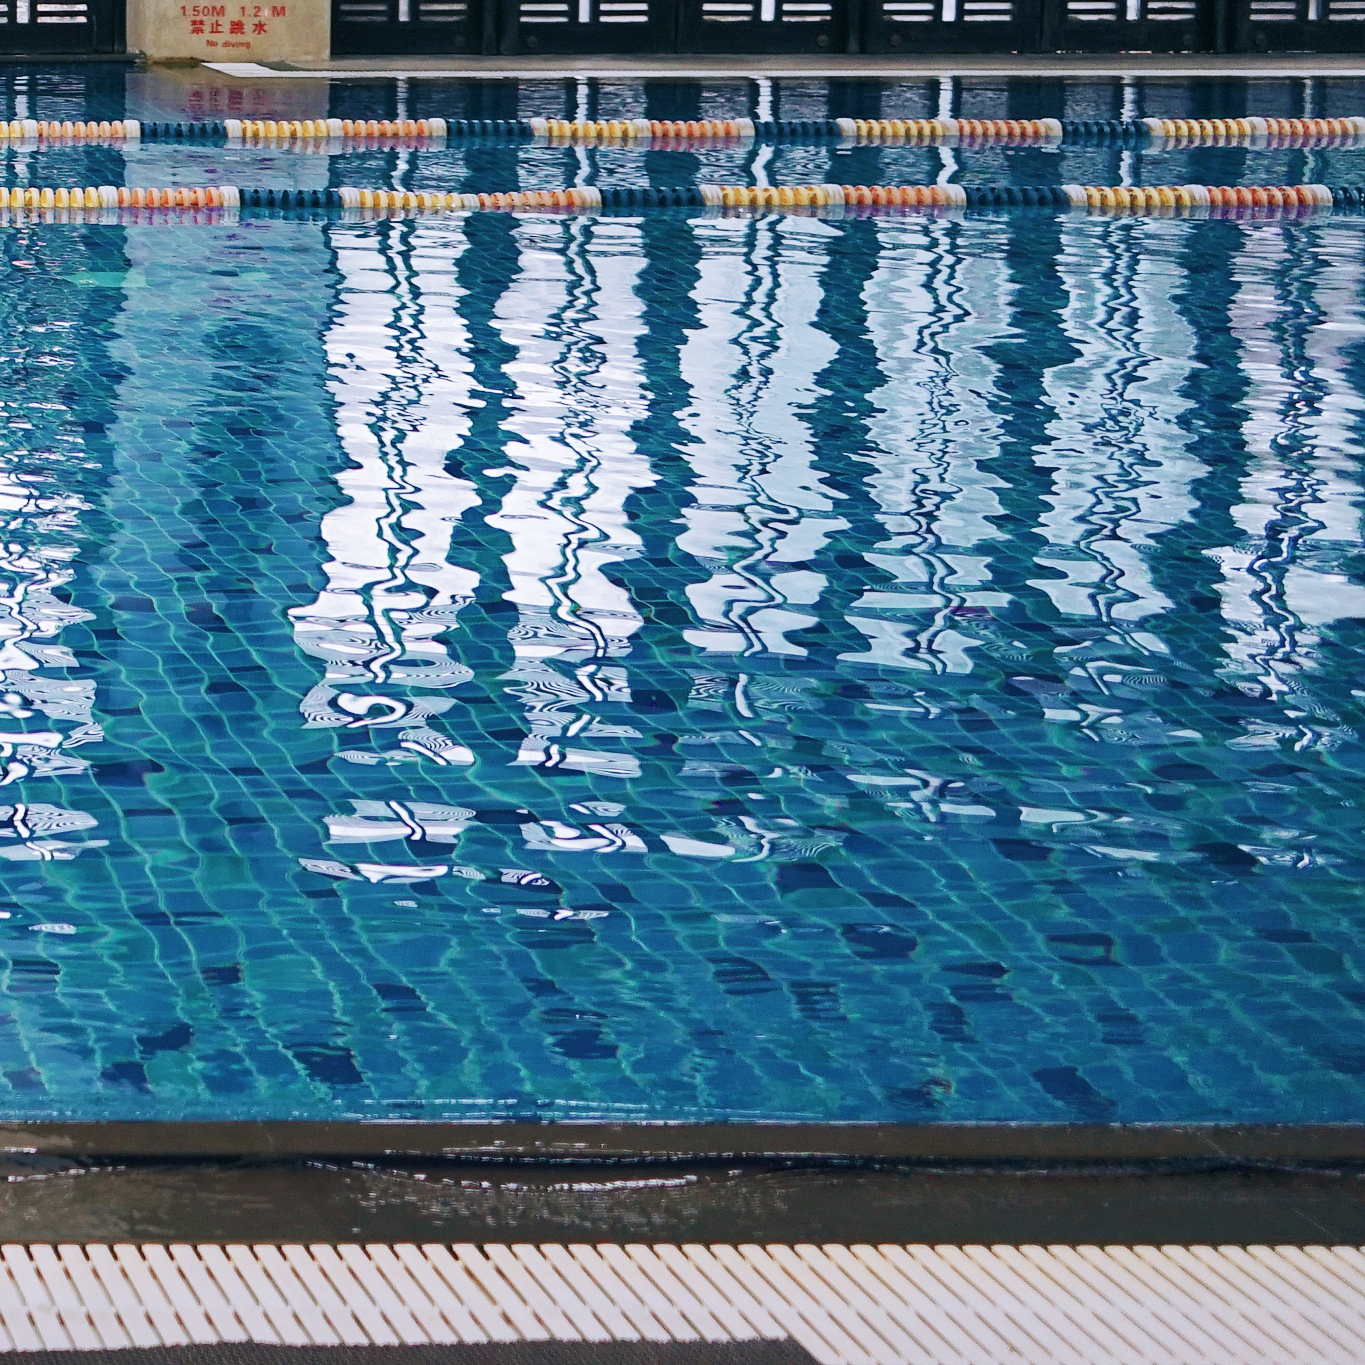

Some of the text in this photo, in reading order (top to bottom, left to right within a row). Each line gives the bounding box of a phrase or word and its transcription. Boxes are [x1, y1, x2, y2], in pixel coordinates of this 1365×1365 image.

[180, 5, 226, 17] 1.50M
[189, 20, 267, 35] 禁止跳水
